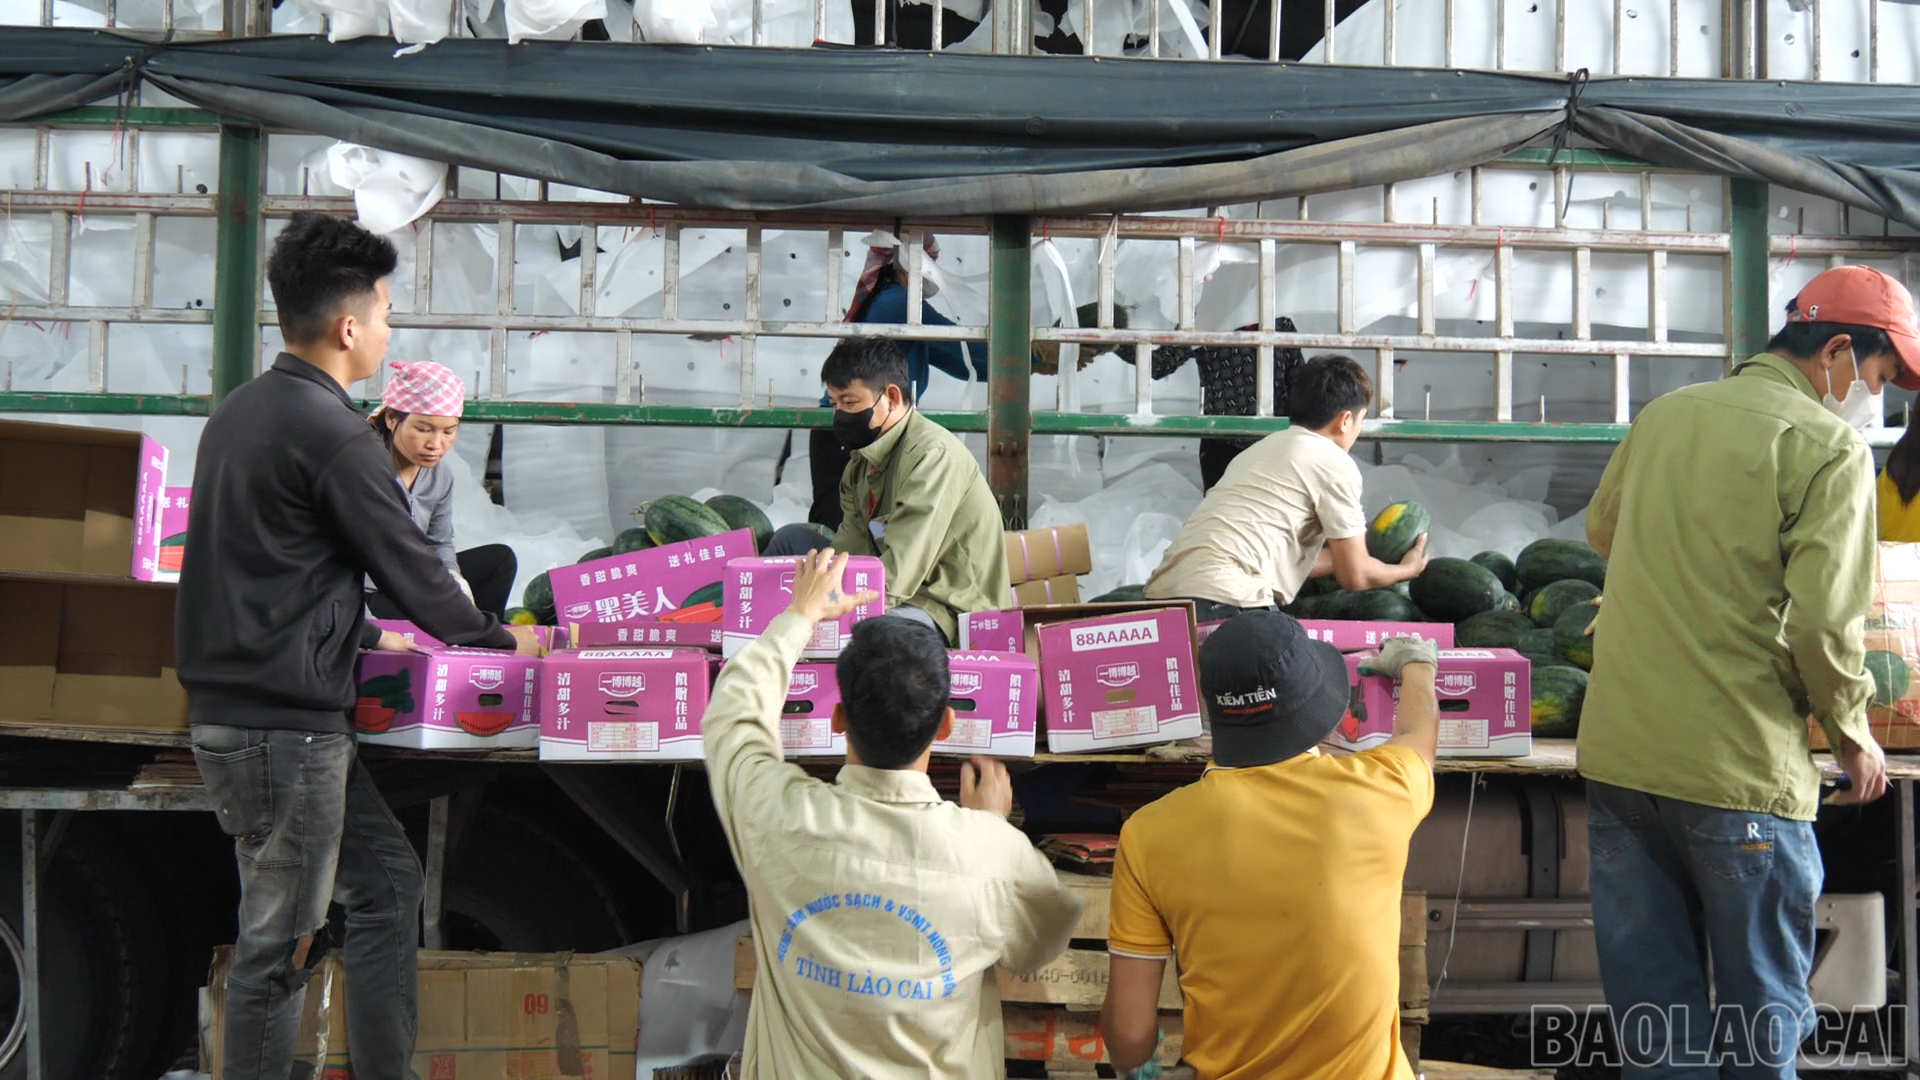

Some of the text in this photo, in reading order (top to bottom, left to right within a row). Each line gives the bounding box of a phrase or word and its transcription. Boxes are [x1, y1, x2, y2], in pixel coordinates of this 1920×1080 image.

[579, 545, 726, 586] 香甜脆爽 送礼佳品
[595, 586, 677, 623] 黑美人
[617, 628, 677, 642] 香甜脆爽
[1076, 627, 1153, 646] 88AAAAA
[556, 672, 571, 730] 清甜多汁
[1058, 669, 1075, 723] 清甜多汁
[1747, 822, 1760, 838] R
[883, 899, 895, 913] &
[847, 970, 892, 997] LÀO
[897, 979, 933, 1000] CAI
[524, 993, 549, 1015] 09
